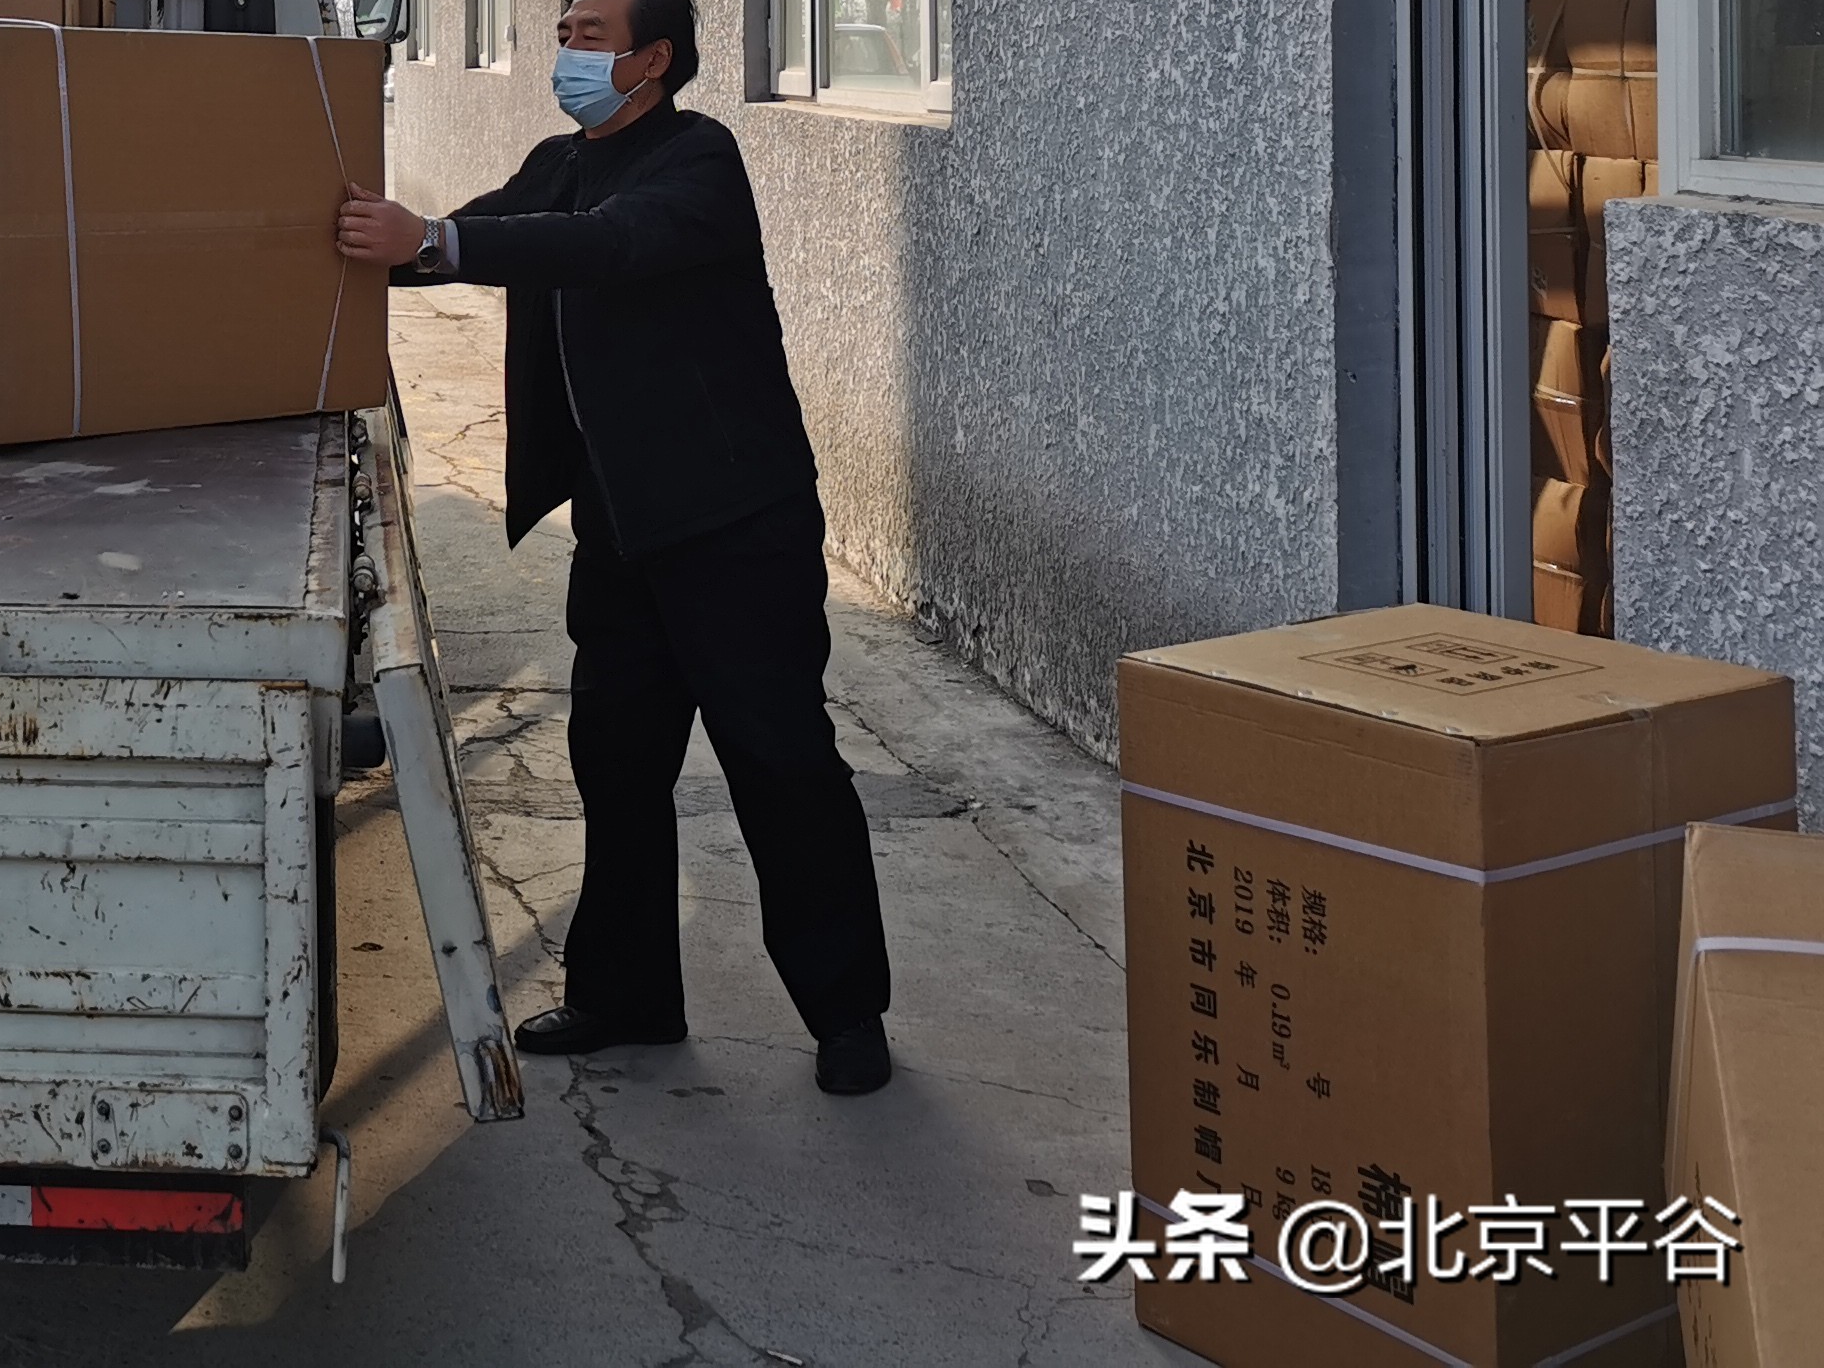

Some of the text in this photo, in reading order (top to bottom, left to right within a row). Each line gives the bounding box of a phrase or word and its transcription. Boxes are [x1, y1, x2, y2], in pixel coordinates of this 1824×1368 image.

[1233, 866, 1255, 935] 2019
[1234, 959, 1258, 989] 年
[1237, 1065, 1260, 1093] 月
[1306, 1072, 1331, 1099] 号
